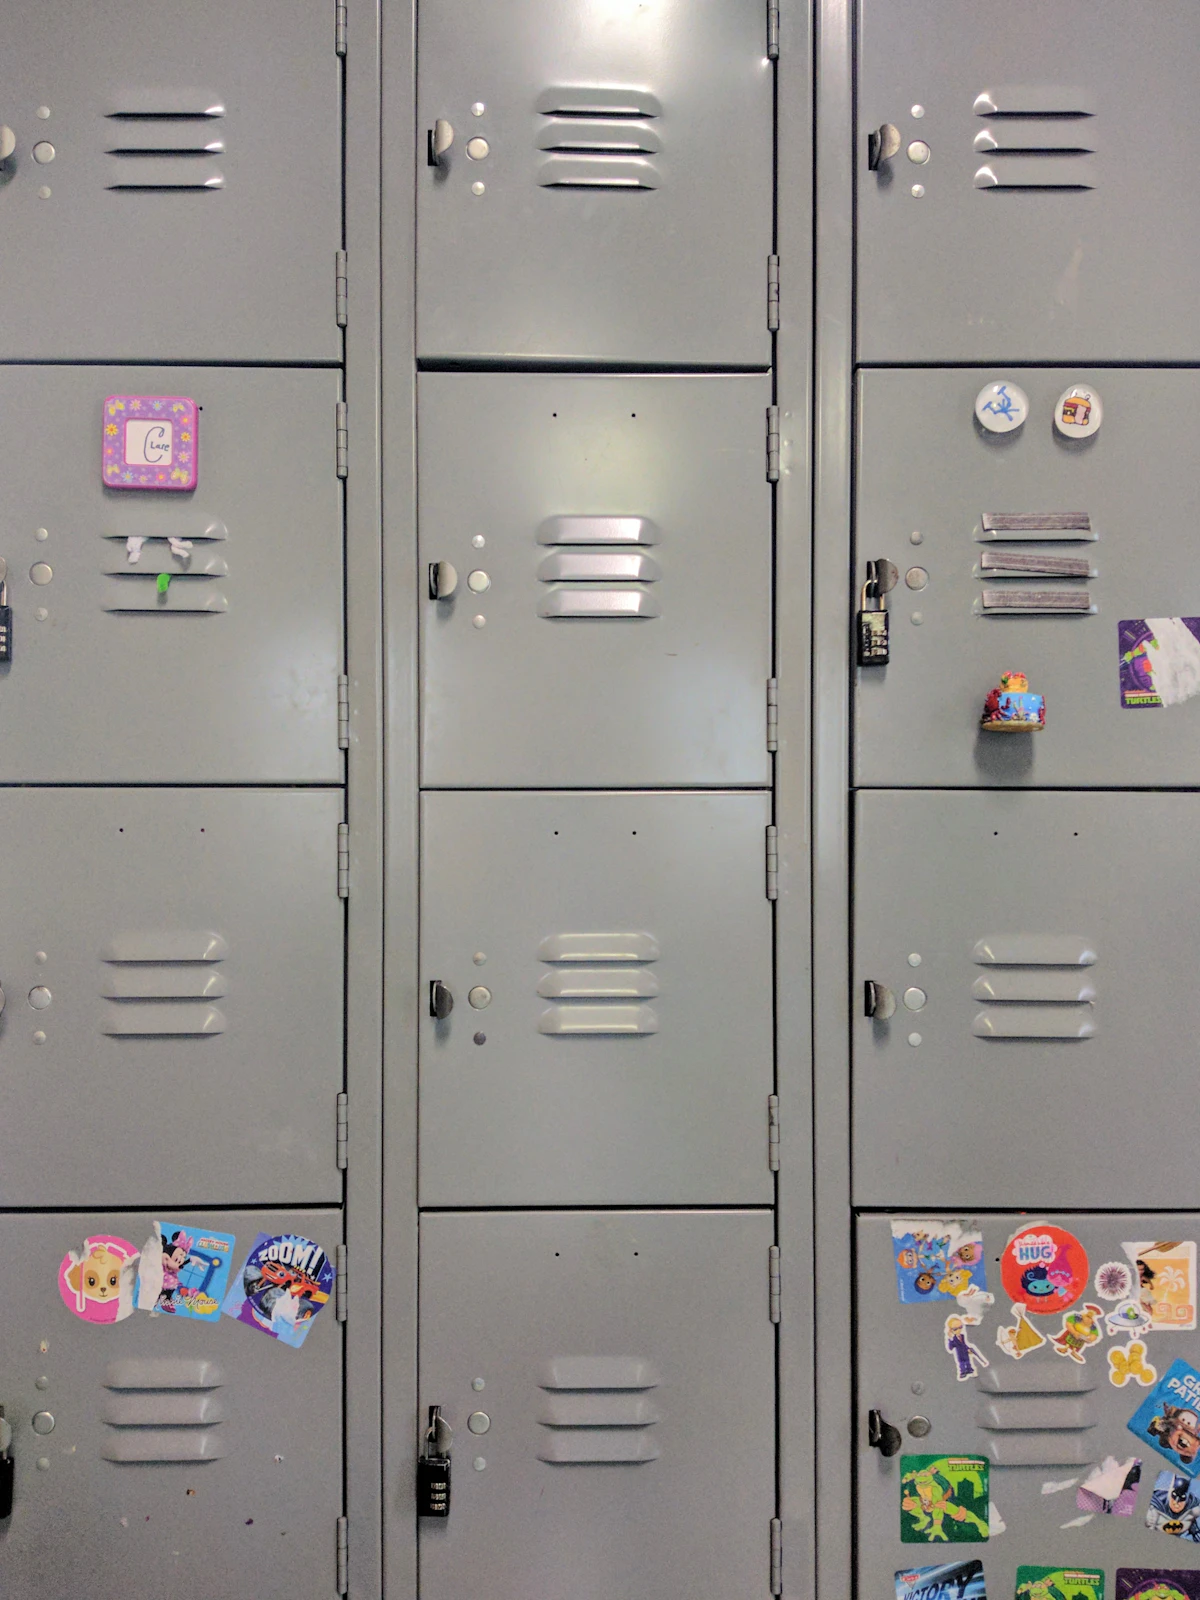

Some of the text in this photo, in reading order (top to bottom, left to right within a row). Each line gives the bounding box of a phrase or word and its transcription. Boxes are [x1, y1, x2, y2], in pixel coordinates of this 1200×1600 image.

[258, 1242, 324, 1275] ZOOM!
[1019, 1246, 1052, 1260] HUG
[903, 1570, 978, 1600] VICTORY
